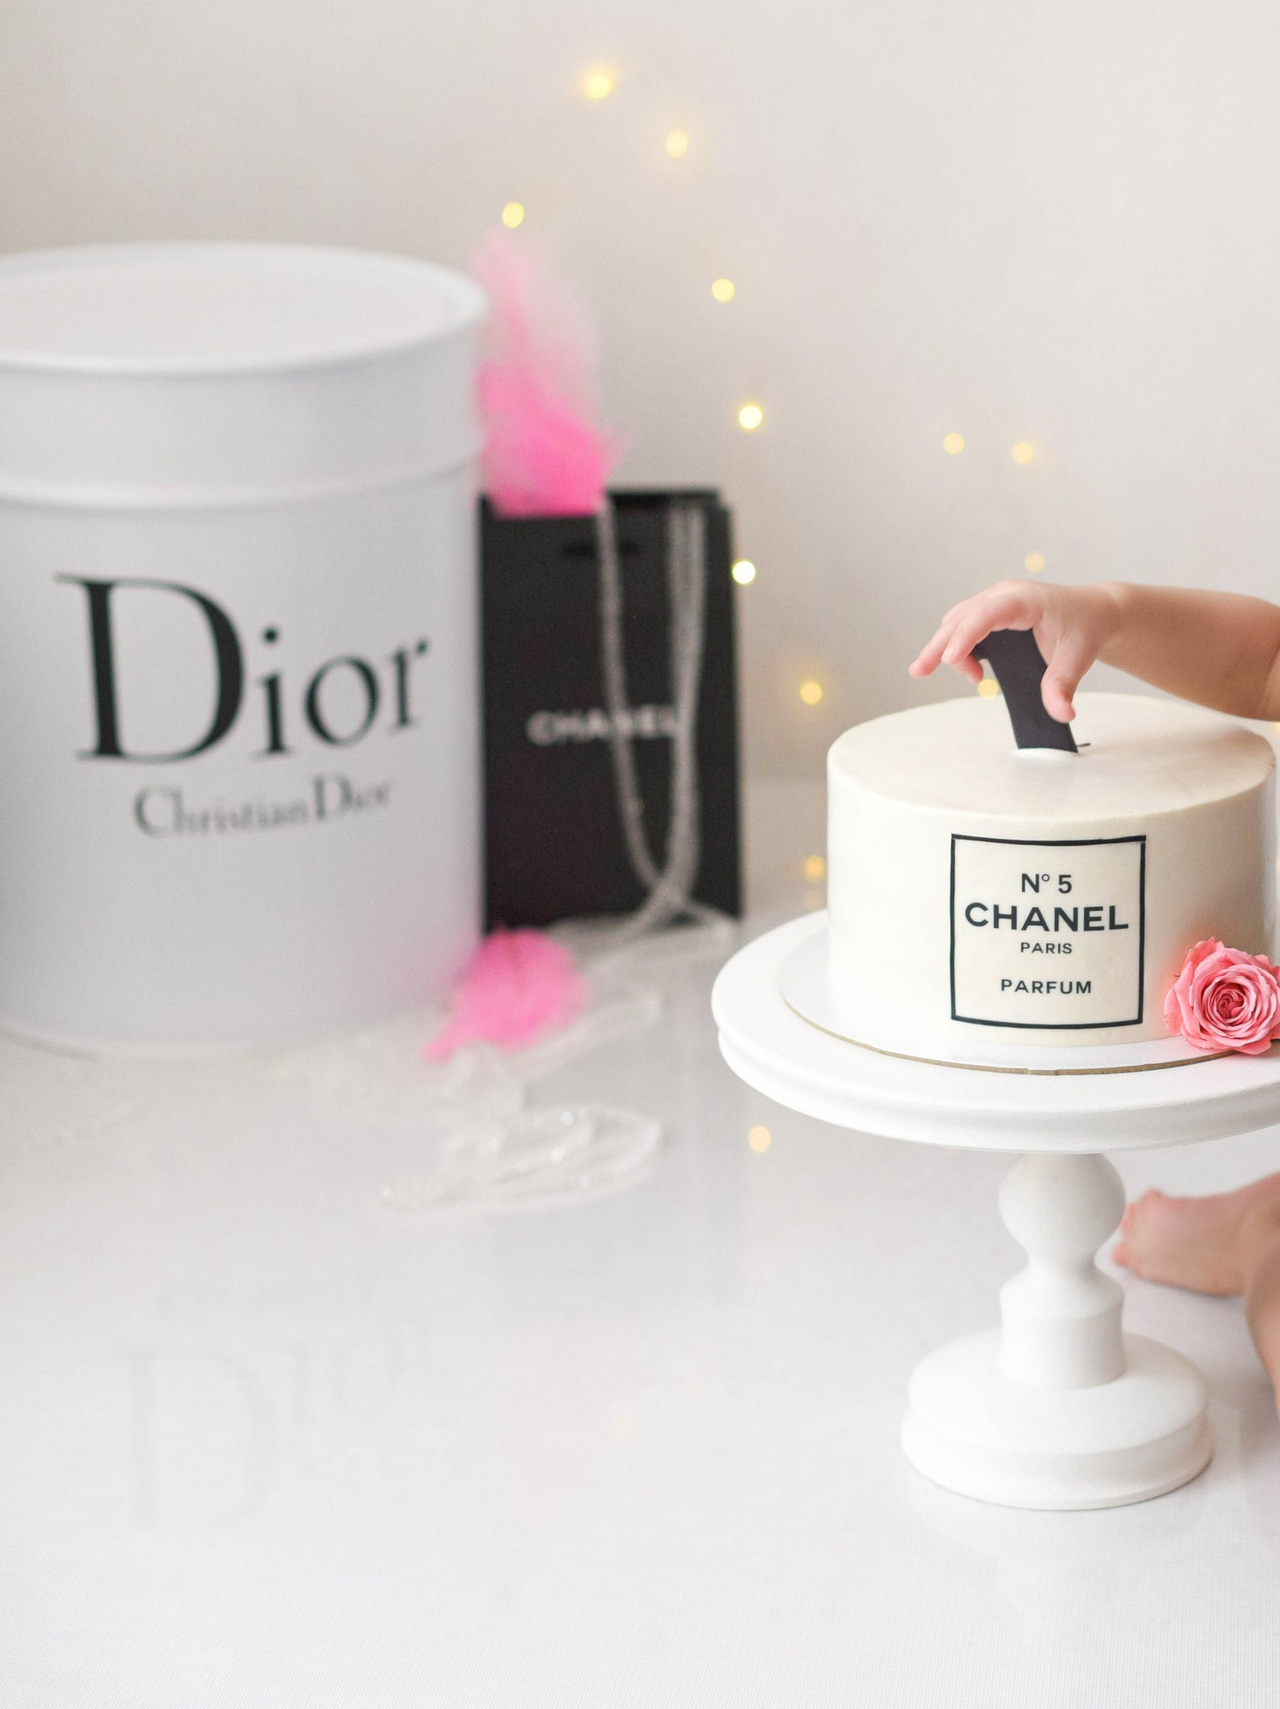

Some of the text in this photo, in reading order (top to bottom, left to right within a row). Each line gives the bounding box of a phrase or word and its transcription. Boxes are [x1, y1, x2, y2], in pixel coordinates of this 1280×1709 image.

[55, 572, 429, 763] Dior
[1058, 874, 1072, 894] 5
[965, 902, 1129, 932] CHANEL
[1020, 942, 1073, 954] PARIS
[1001, 979, 1092, 994] PARFUM
